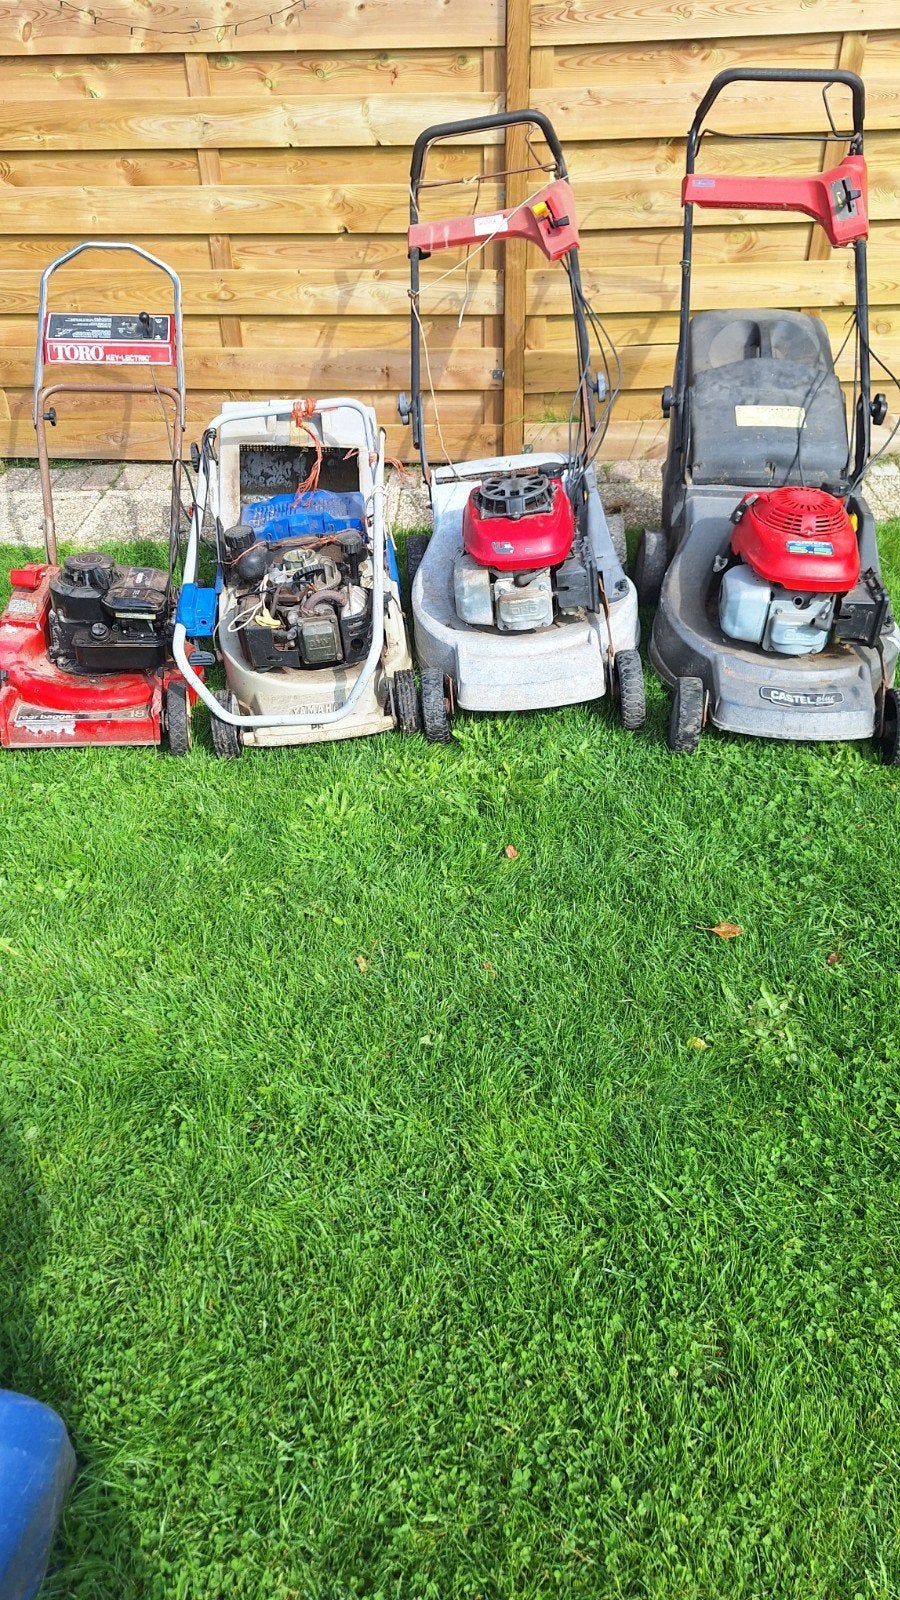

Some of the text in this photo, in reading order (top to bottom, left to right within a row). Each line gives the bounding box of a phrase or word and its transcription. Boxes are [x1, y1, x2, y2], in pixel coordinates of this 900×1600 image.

[53, 344, 105, 361] TORO
[770, 690, 836, 706] CASTEL plus
[40, 712, 76, 720] bagger
[129, 709, 146, 718] 18
[292, 701, 345, 715] YAMAHA
